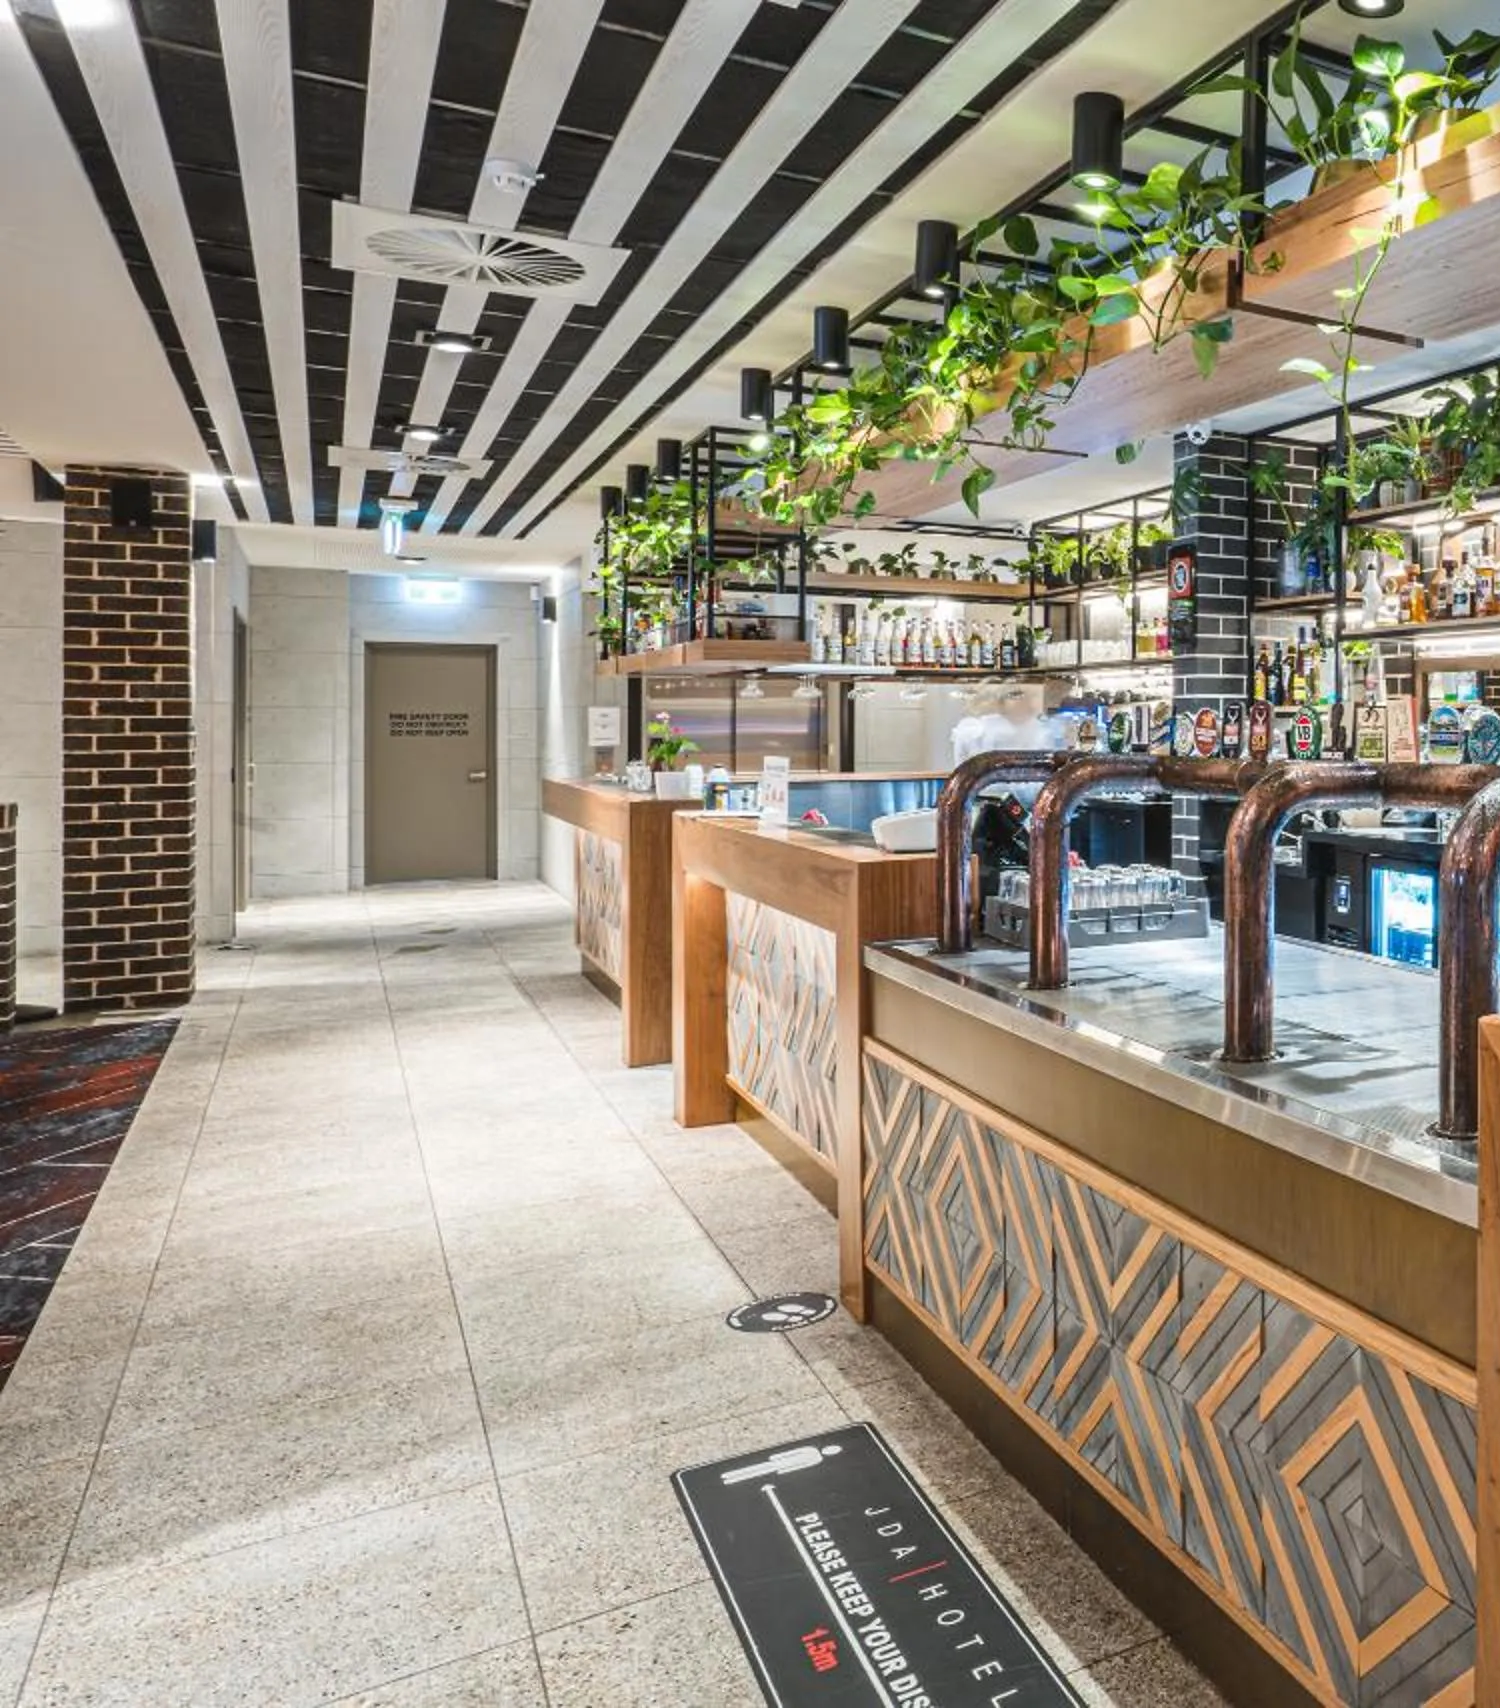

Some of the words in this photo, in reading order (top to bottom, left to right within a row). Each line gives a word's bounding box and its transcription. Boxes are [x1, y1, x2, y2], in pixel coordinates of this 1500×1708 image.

[863, 1506, 918, 1561] JDA
[795, 1511, 848, 1574] PLEASE
[828, 1569, 876, 1618] KEEP
[857, 1617, 908, 1677] YOUR
[888, 1673, 936, 1708] DIS
[801, 1625, 839, 1673] 1.5m
